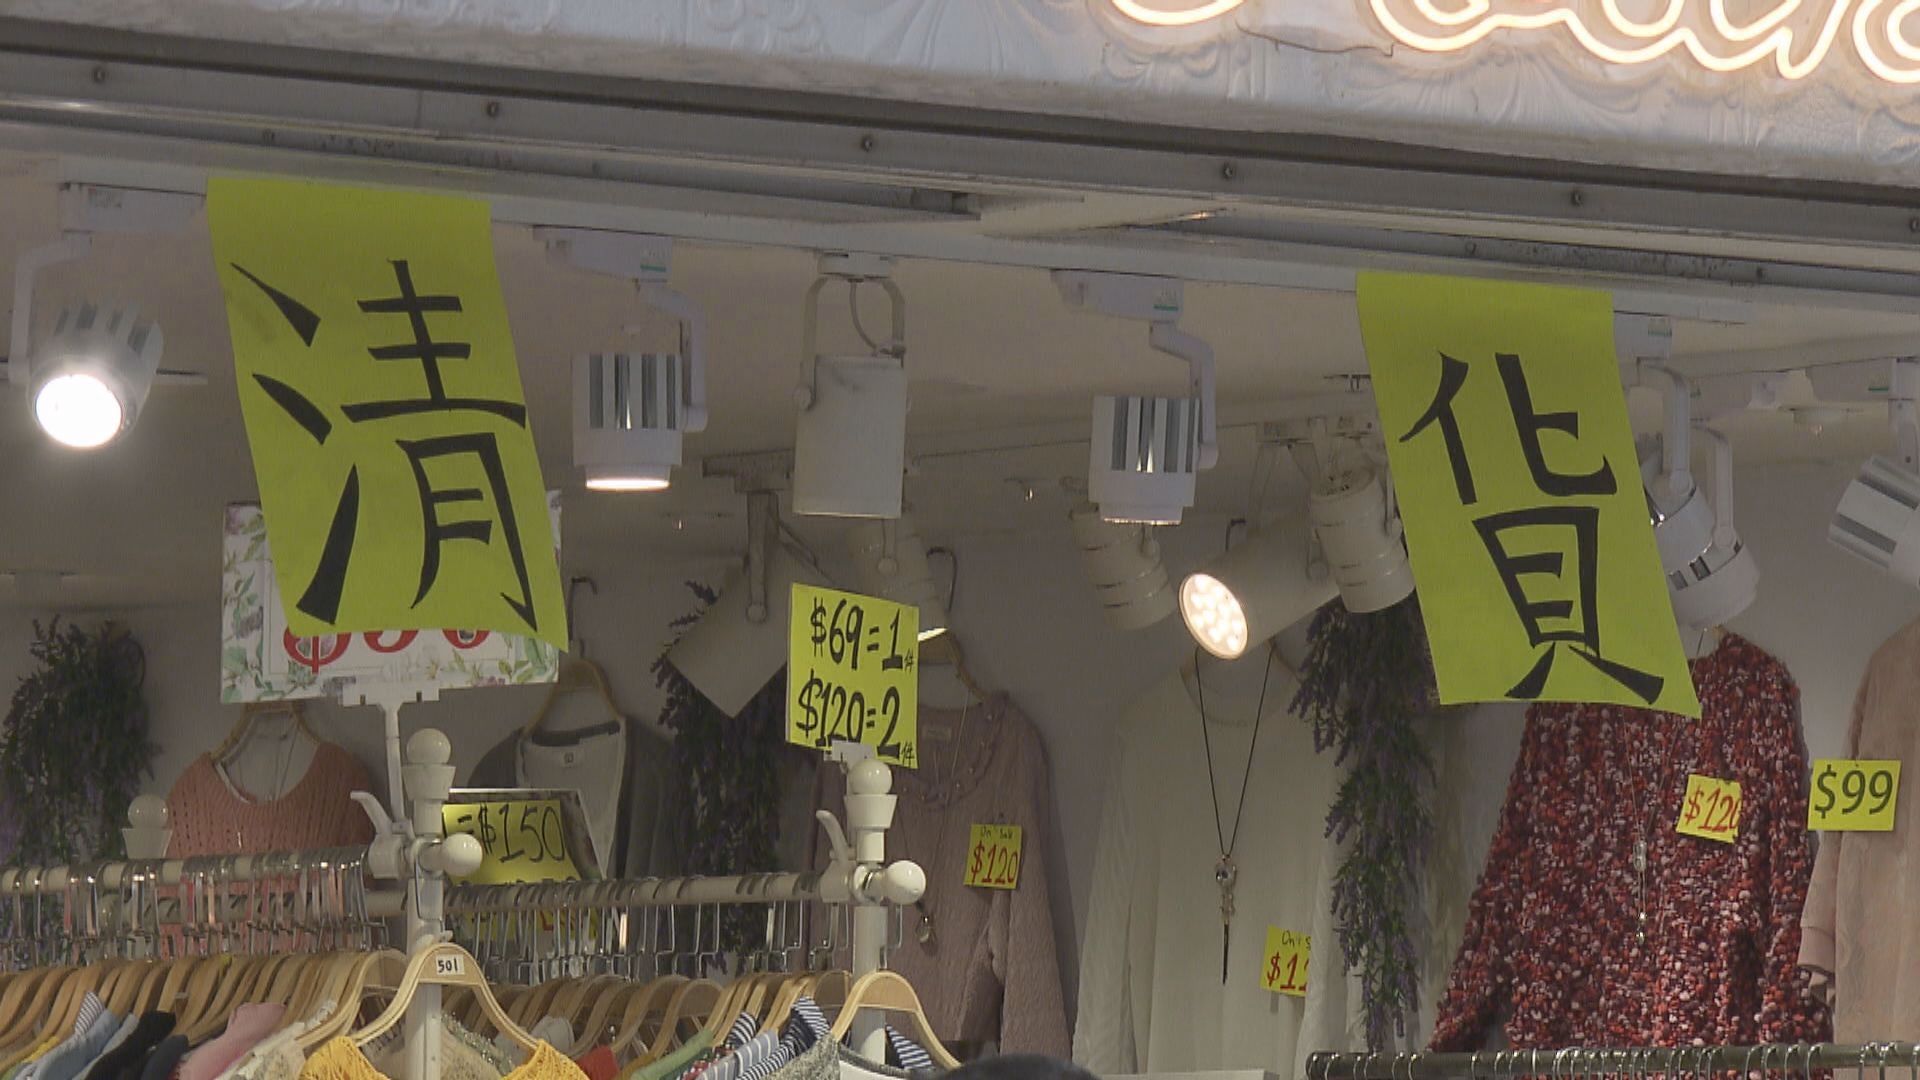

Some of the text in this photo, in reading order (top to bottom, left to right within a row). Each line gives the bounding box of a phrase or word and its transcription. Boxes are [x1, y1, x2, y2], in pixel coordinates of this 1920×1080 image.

[230, 258, 537, 632] 清
[1399, 351, 1665, 706] 貨
[1814, 764, 1893, 819] $99
[971, 840, 1019, 885] $120
[437, 956, 459, 973] 501
